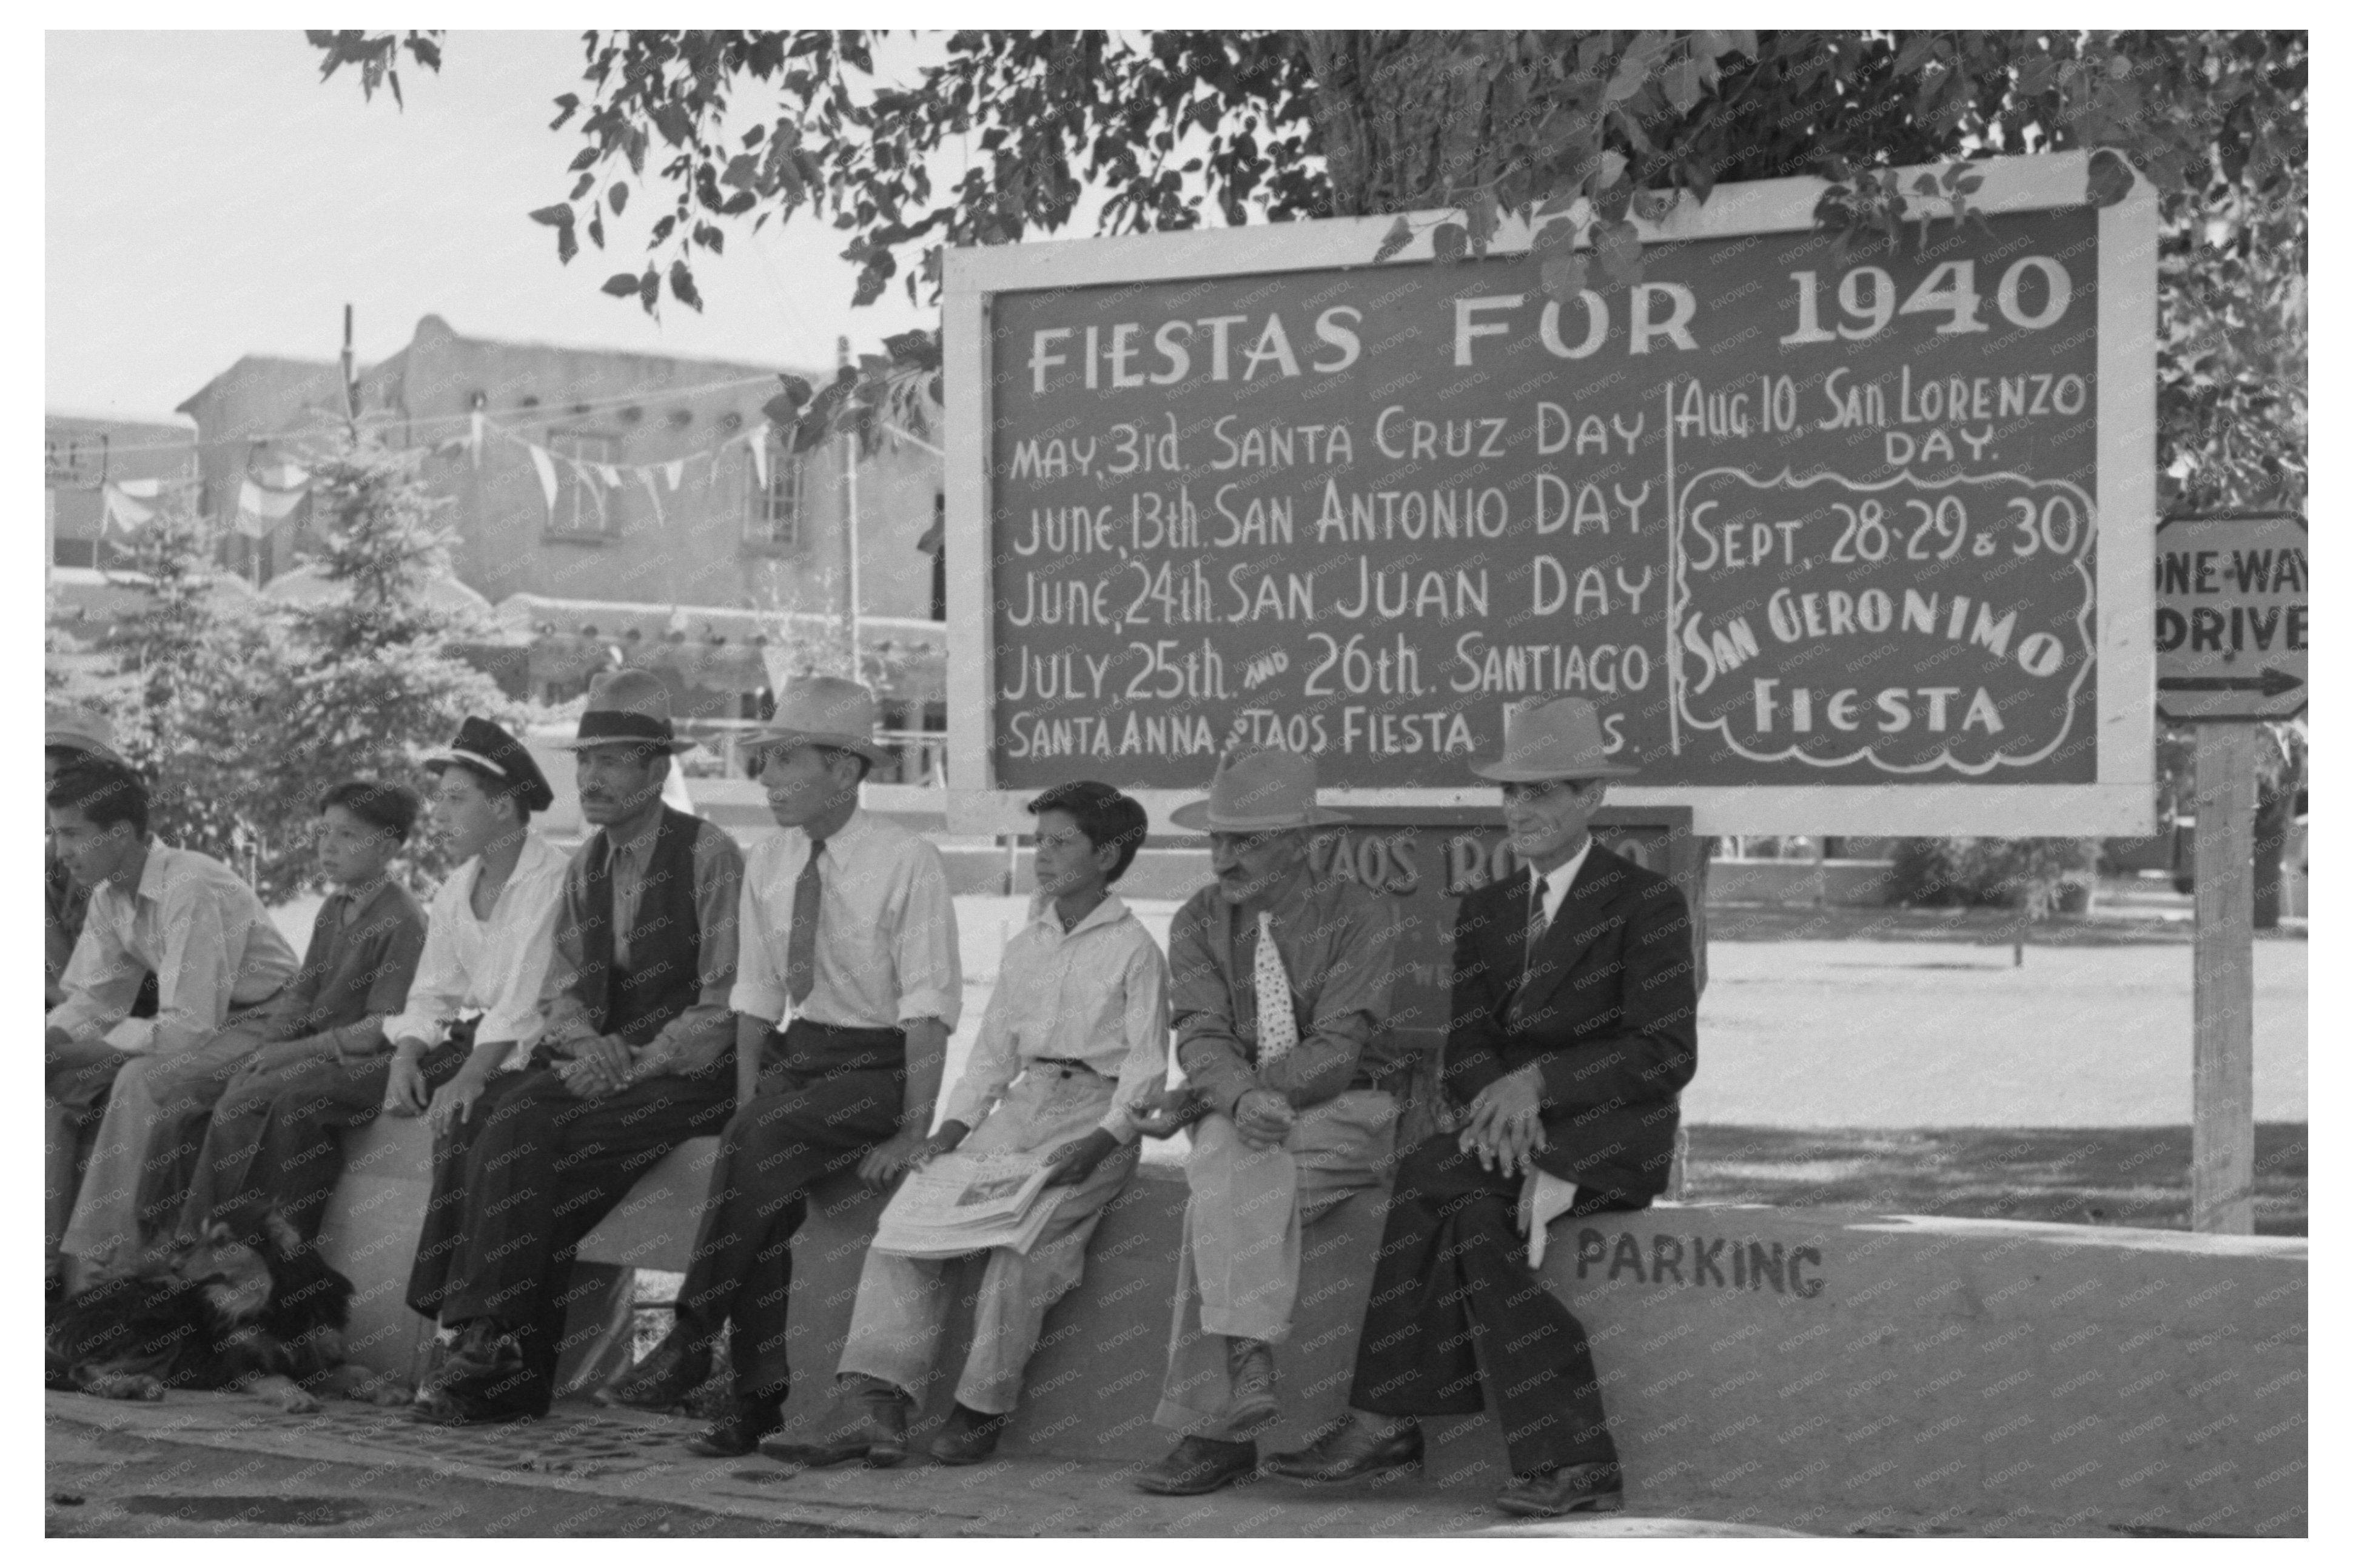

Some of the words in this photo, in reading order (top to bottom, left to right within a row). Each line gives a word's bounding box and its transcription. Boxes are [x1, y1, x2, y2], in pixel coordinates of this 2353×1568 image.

[1028, 306, 1363, 393] FIESTAS
[1455, 282, 1699, 365] FOR
[1780, 255, 2072, 344] 1940
[1902, 365, 2086, 424] LORENZO
[1210, 415, 1353, 470] SANTA
[1375, 405, 1508, 461] CRUZ
[1538, 401, 1644, 454] DAY
[1887, 424, 1999, 466] DAY.
[1213, 483, 1293, 547] SAN
[1317, 478, 1508, 543] ANTONIO
[1536, 474, 1650, 535] DAY
[1973, 531, 1996, 557] &
[2007, 495, 2079, 557] 30
[1227, 561, 1314, 622] SAN
[1336, 555, 1488, 618] JUAN
[1534, 554, 1651, 615] DAY
[1244, 651, 1289, 689] AND
[1451, 631, 1650, 693] SANTIAGO
[1682, 611, 1759, 694] SAN
[1768, 587, 2064, 677] GERONIMO
[1009, 711, 1111, 757] SANTA
[1119, 709, 1215, 756] ANNA
[1243, 709, 1328, 753] TAOS
[1344, 705, 1476, 754] FIESTA
[1754, 677, 2004, 734] FIESTA
[1309, 834, 1418, 893] TAOS
[1577, 1227, 1825, 1299] PARKING
